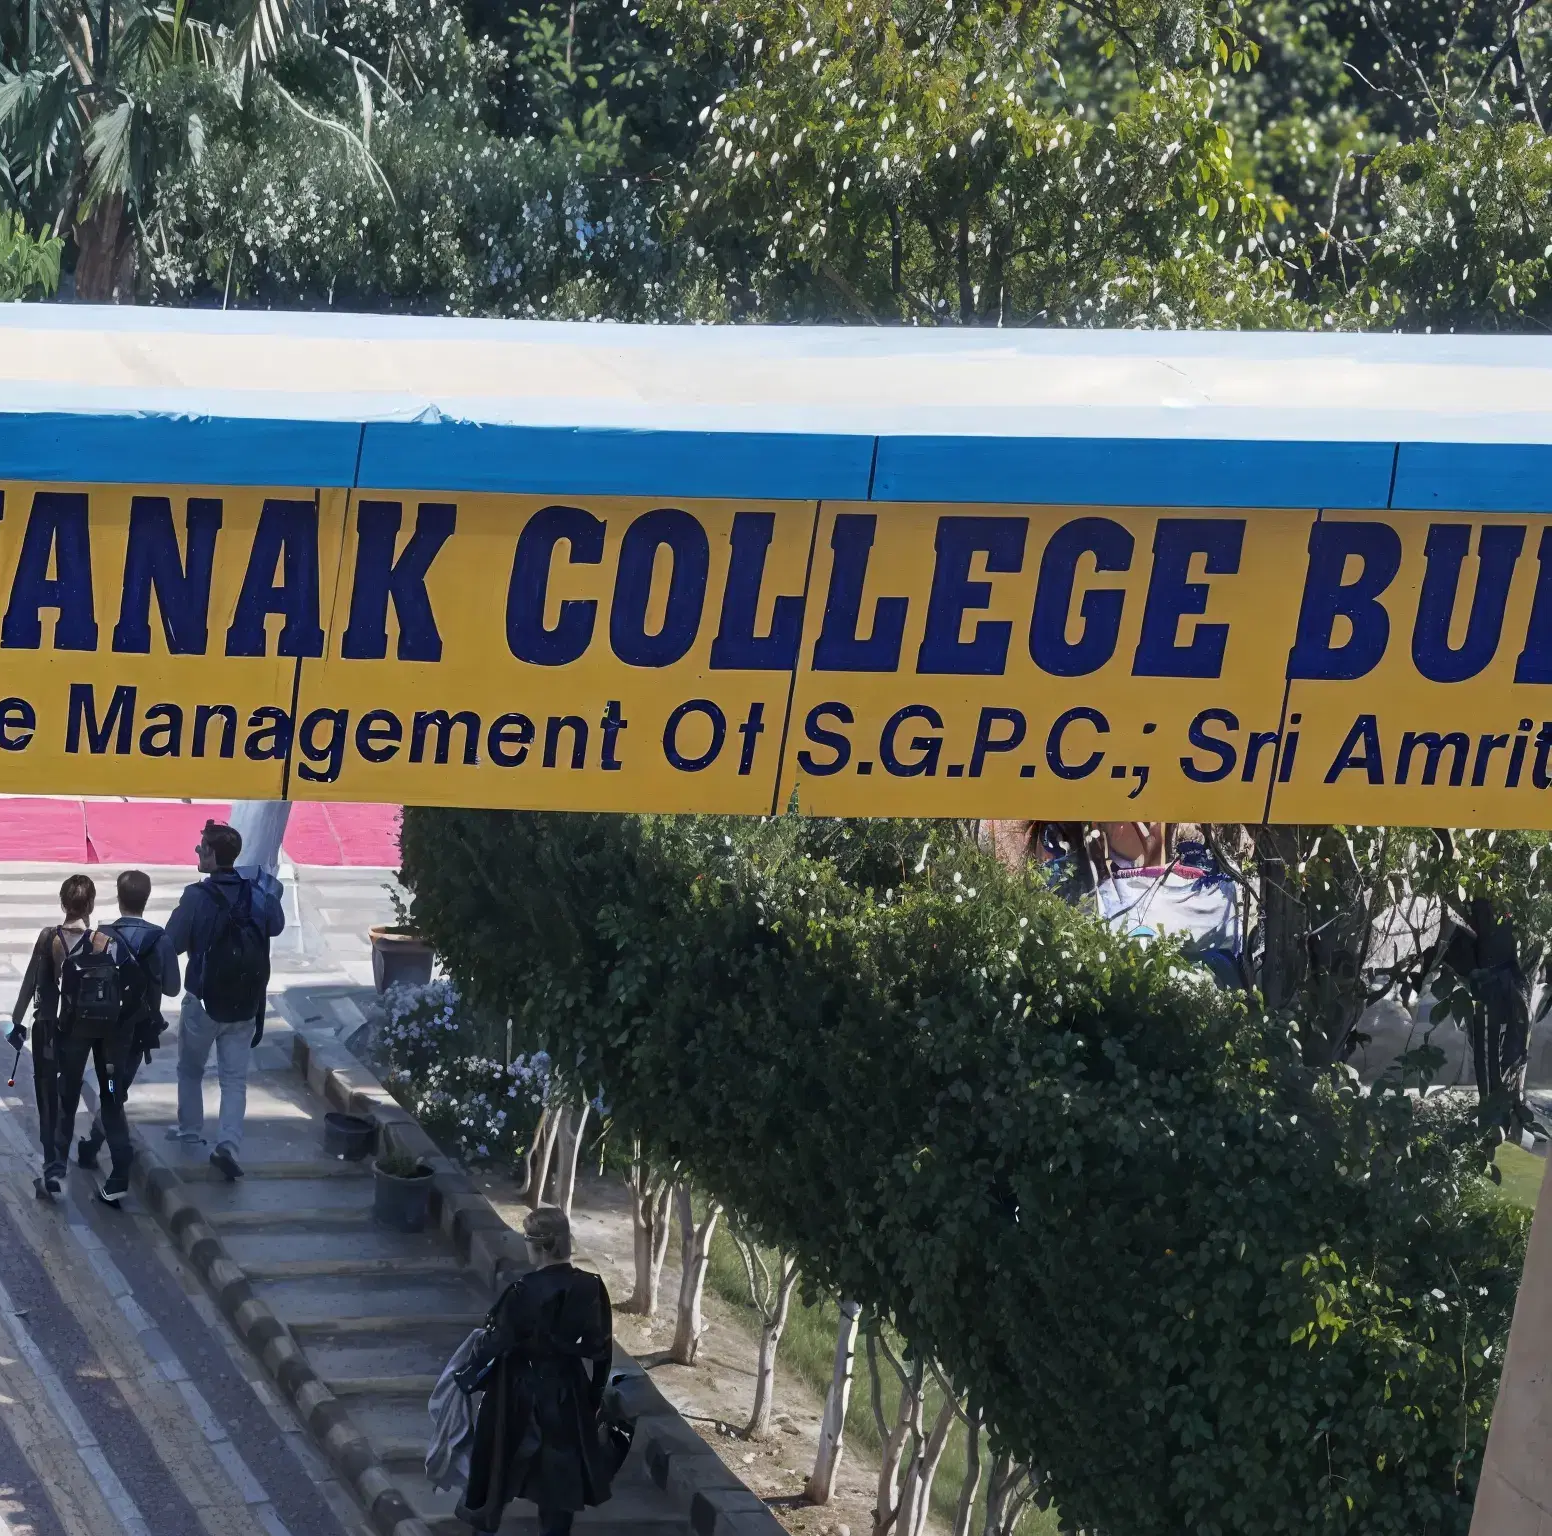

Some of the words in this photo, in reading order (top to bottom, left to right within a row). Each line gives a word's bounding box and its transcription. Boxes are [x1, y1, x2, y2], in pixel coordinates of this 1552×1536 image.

[505, 505, 1248, 679] COLLEGE
[64, 683, 629, 784] Management
[662, 698, 765, 776] Of
[1179, 707, 1302, 785] Sri
